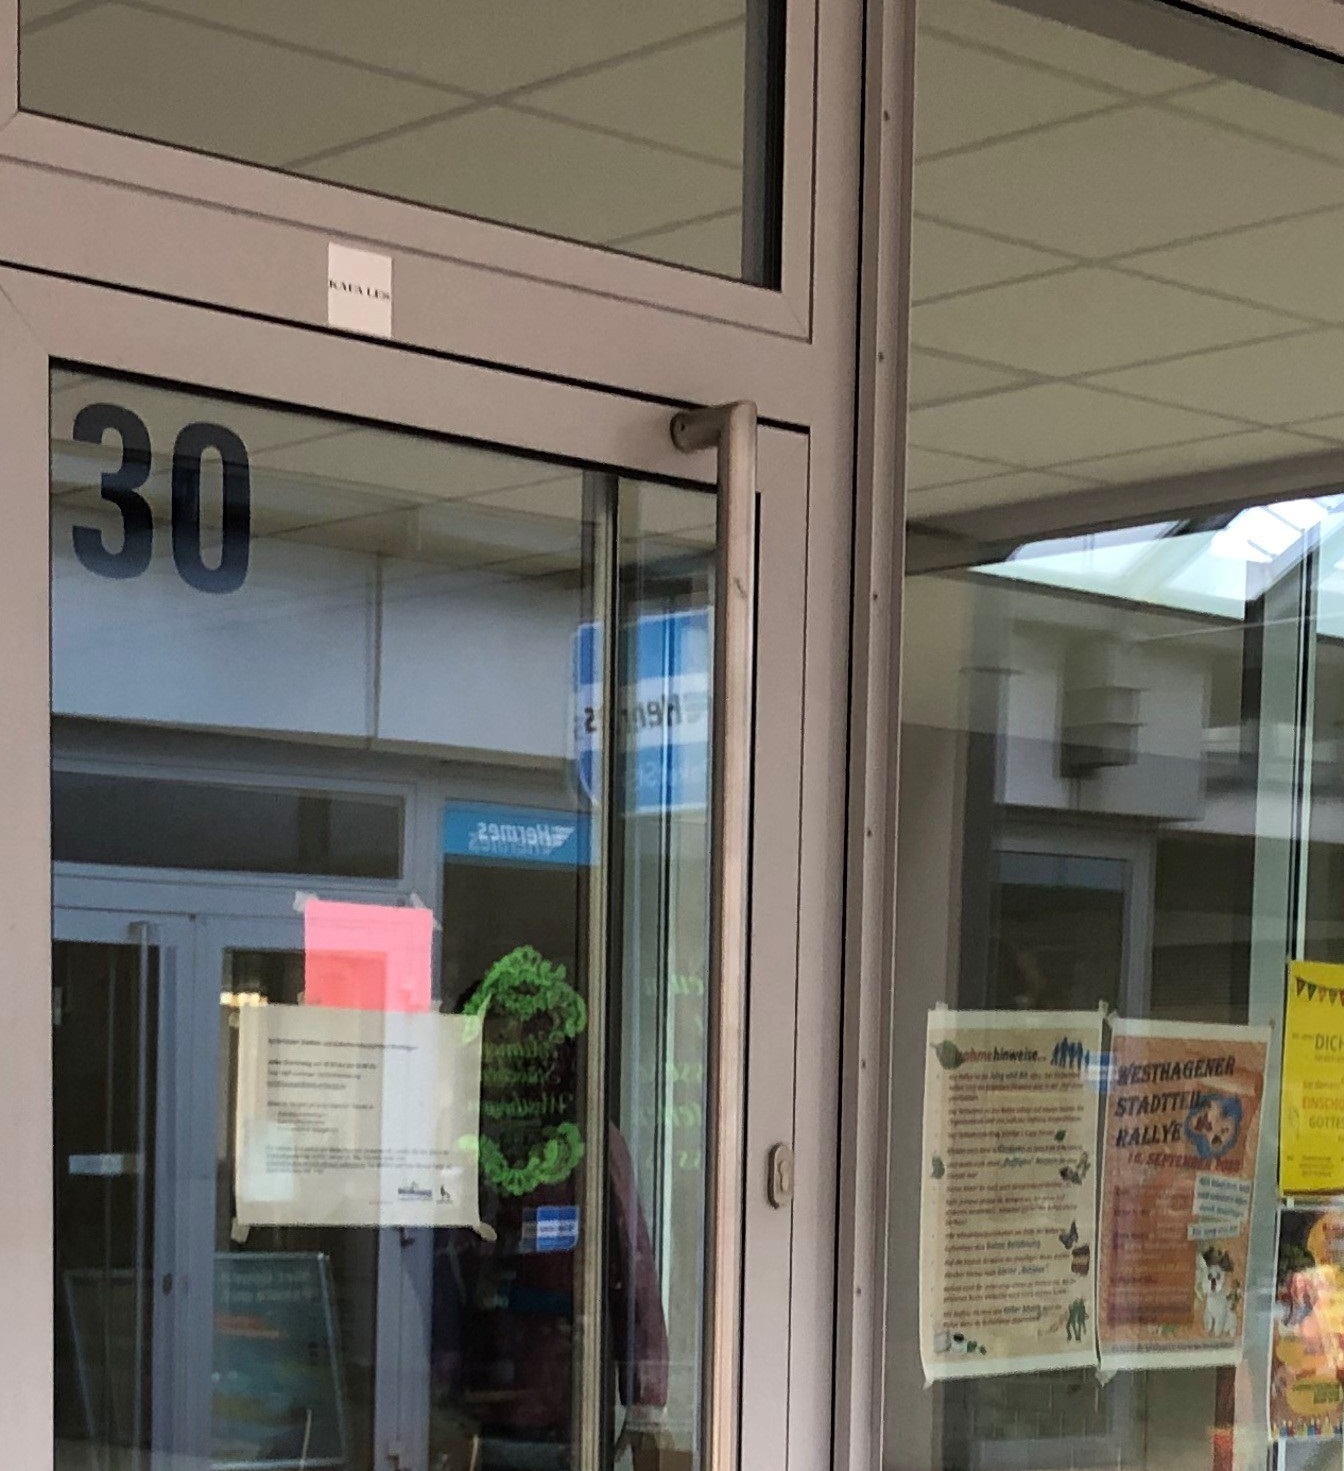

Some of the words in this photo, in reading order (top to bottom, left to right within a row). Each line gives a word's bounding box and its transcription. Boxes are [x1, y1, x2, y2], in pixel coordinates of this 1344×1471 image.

[72, 402, 251, 595] 30
[1116, 1055, 1236, 1086] WESTHAGENER
[1115, 1119, 1183, 1147] RALLYE
